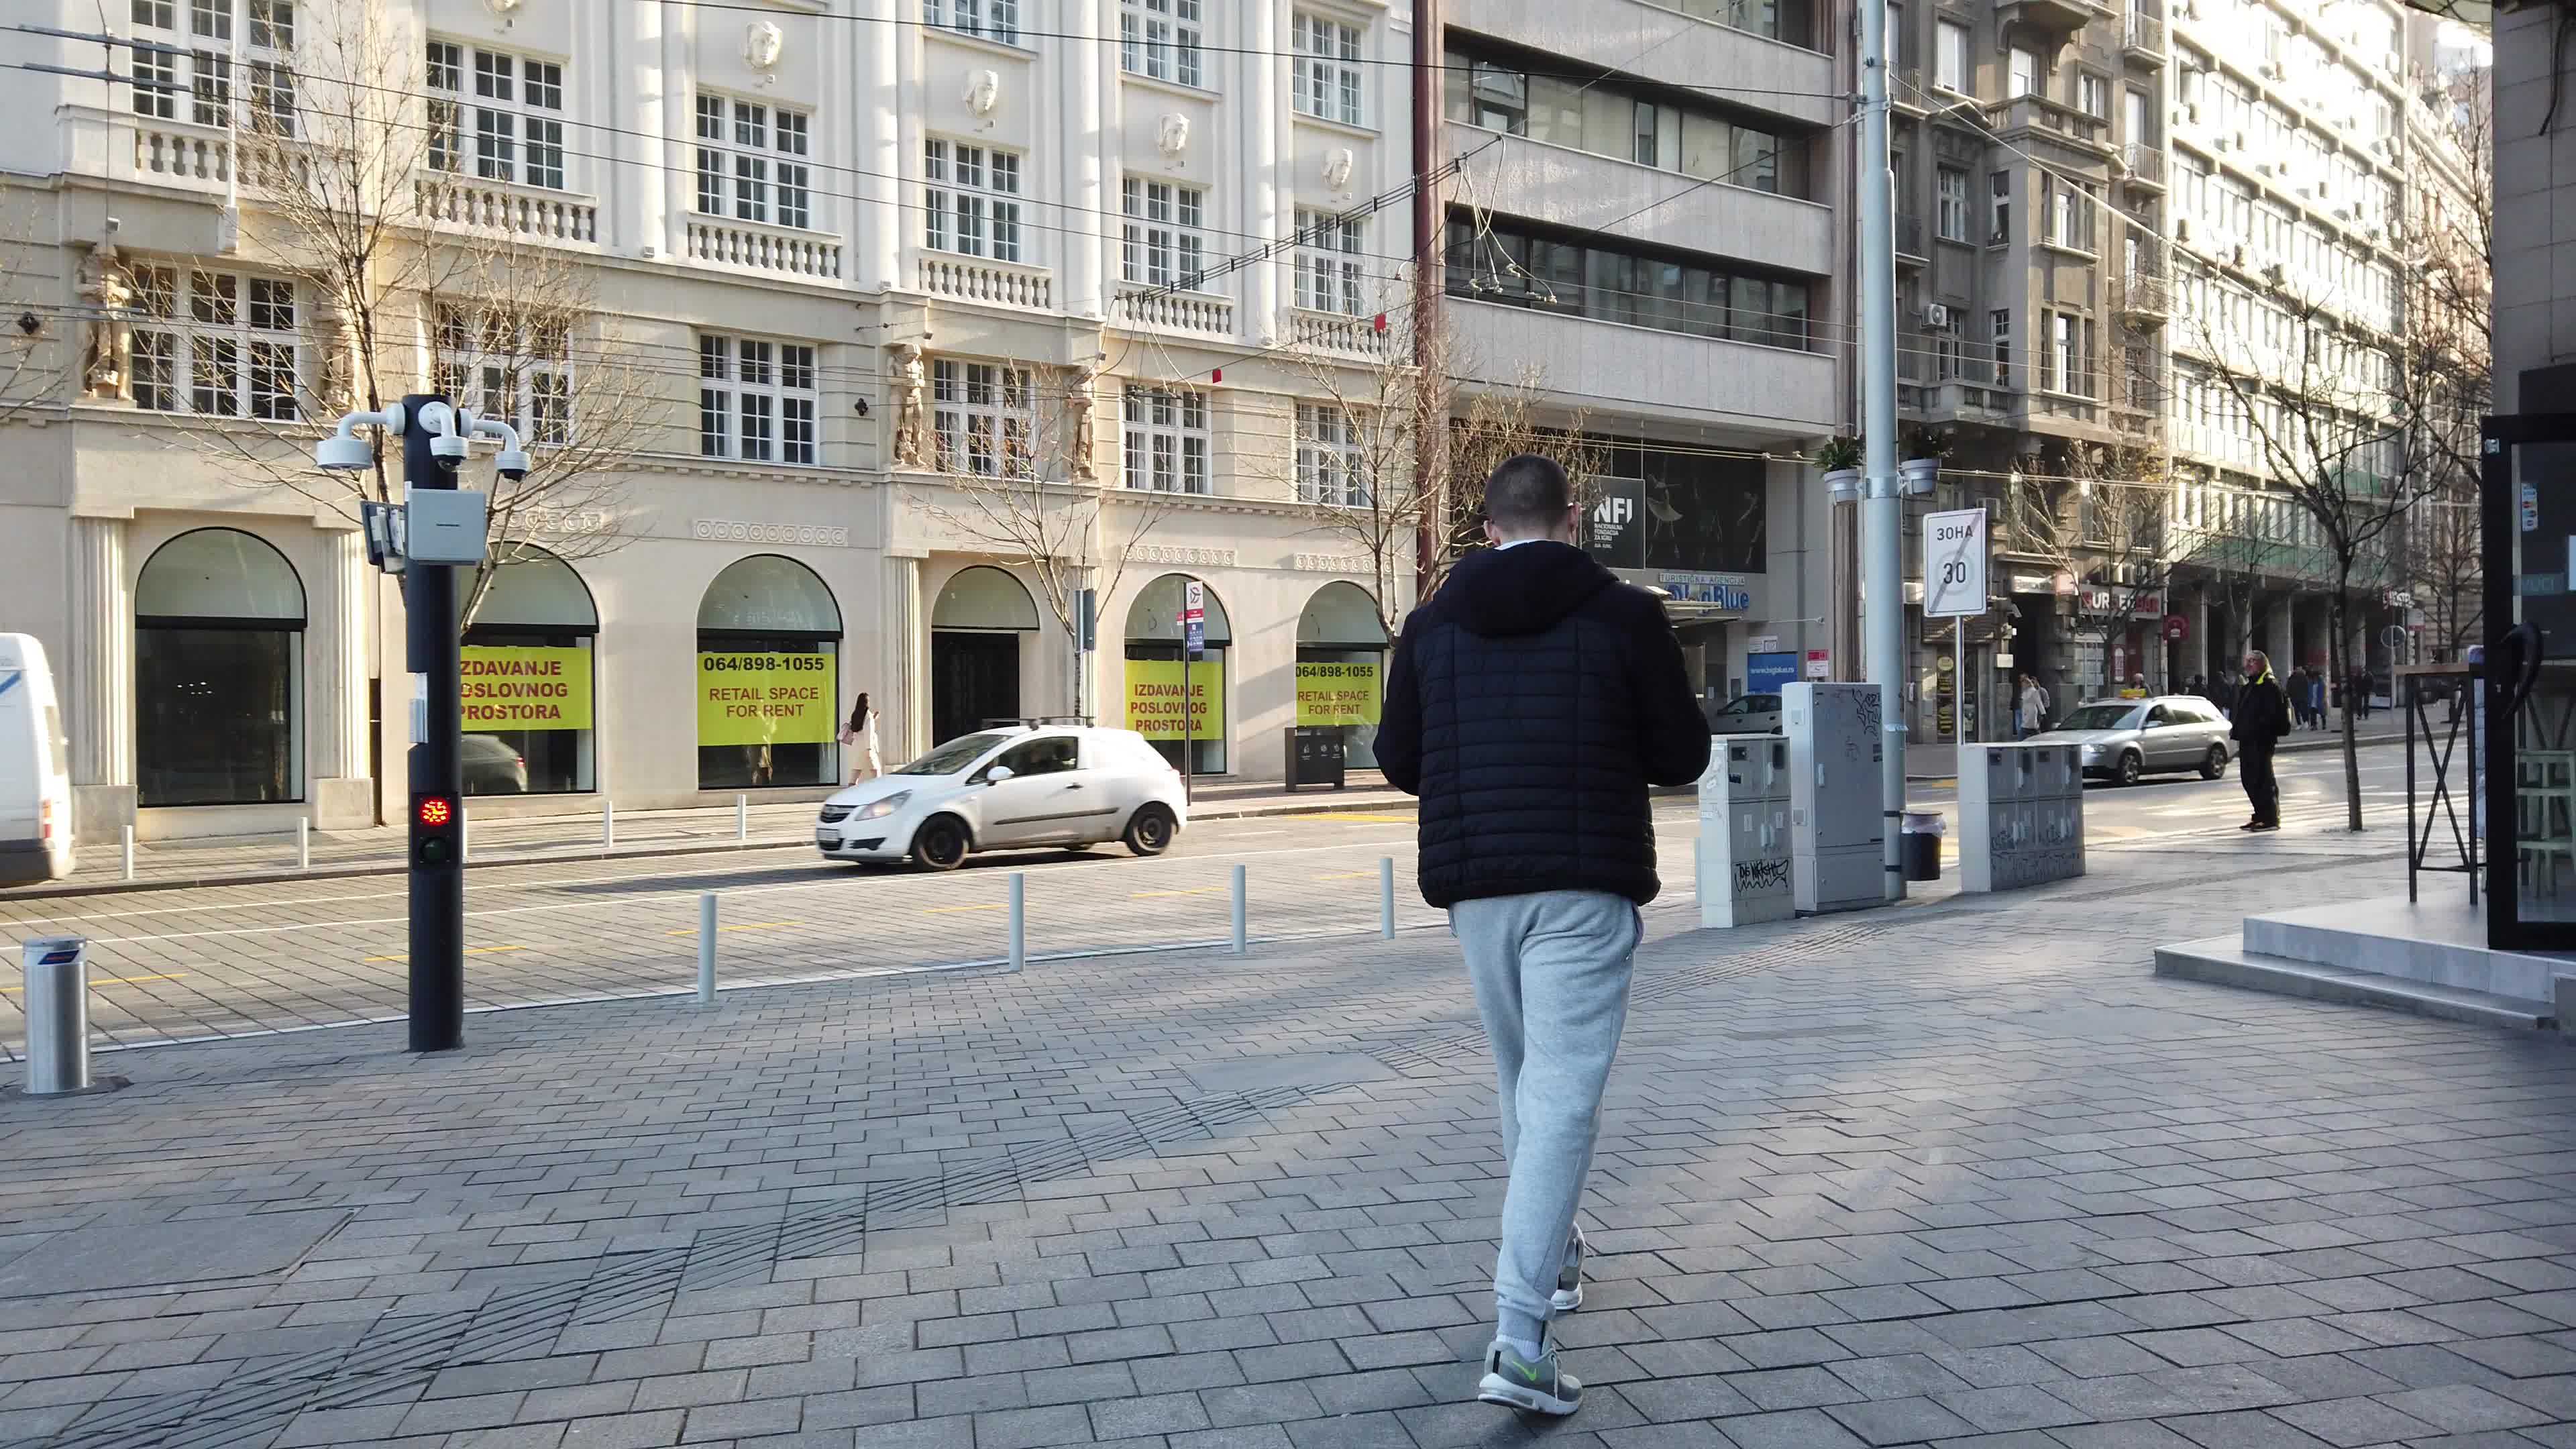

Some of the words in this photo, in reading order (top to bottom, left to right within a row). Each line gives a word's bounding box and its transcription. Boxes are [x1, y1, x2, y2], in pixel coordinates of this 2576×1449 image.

[1594, 494, 1633, 523] NFI
[1943, 561, 1966, 584] 30
[460, 660, 561, 676] ZDAVANJE
[704, 657, 824, 671] 064/898-1055
[1295, 666, 1374, 678] 064/898-1055
[461, 682, 568, 698] OSLOVNOG
[709, 688, 765, 701] RETAIL
[769, 687, 819, 700] SPACE
[1298, 690, 1335, 702] RETAIL
[1337, 690, 1369, 701] SPACE
[727, 705, 757, 718] FOR
[763, 704, 804, 716] RENT
[1309, 705, 1330, 715] FOR
[1333, 704, 1361, 714] RENT
